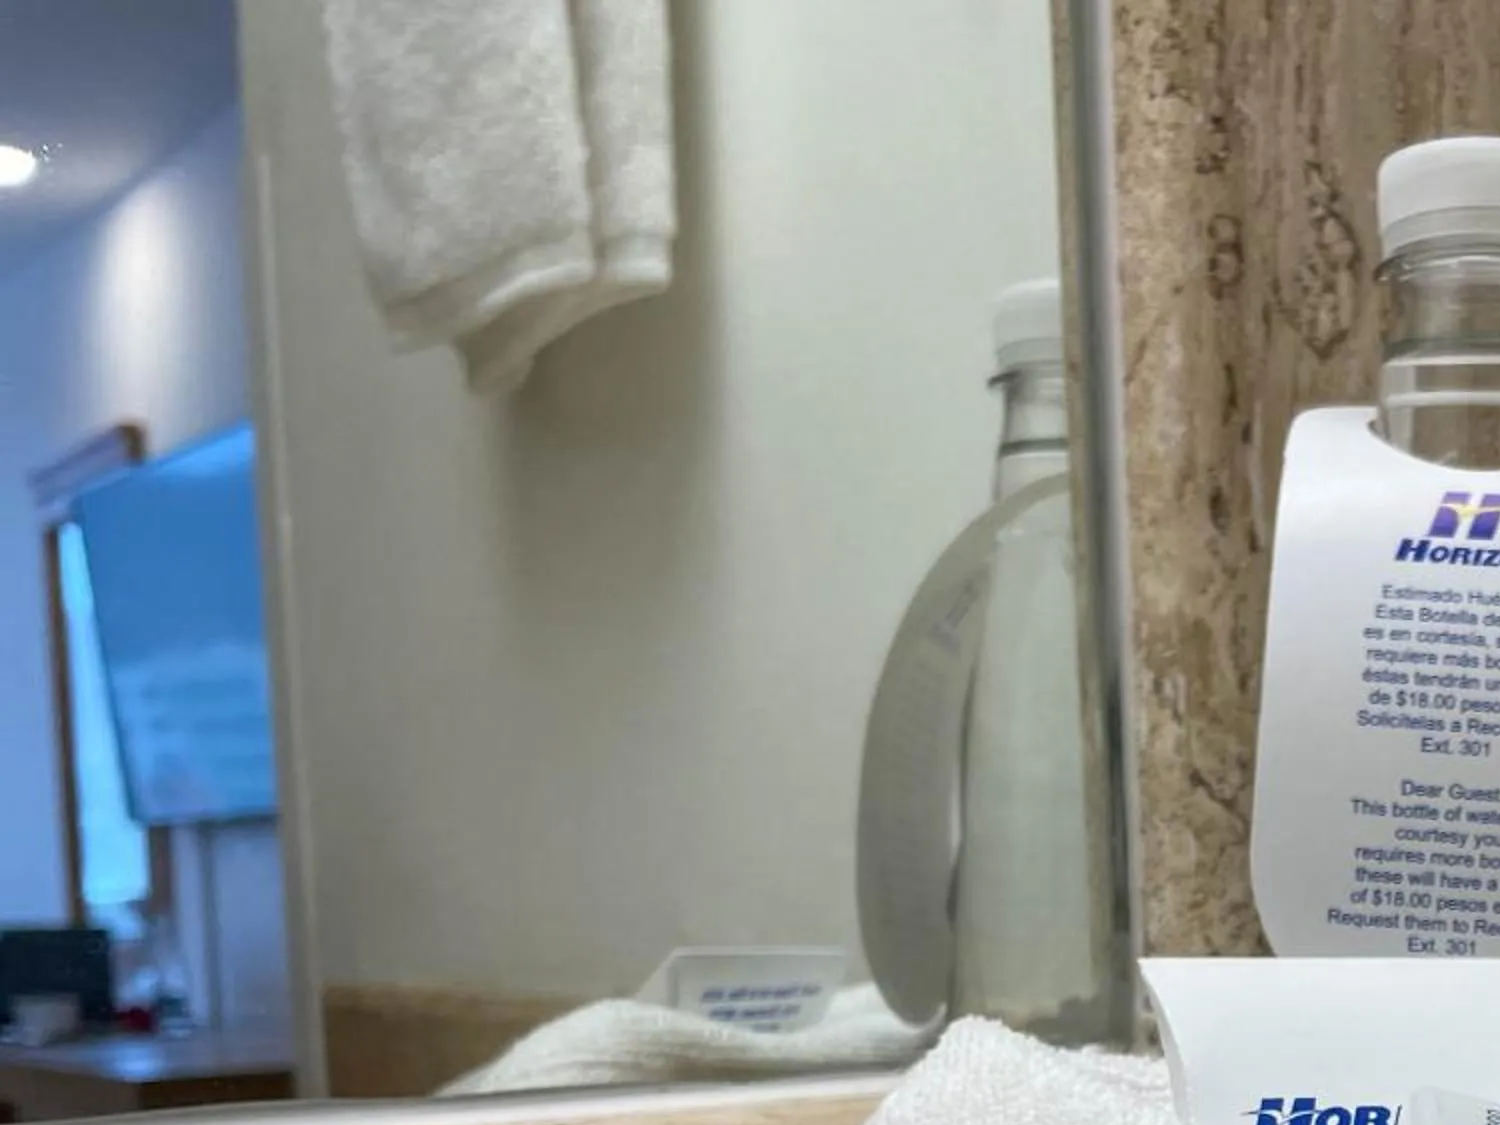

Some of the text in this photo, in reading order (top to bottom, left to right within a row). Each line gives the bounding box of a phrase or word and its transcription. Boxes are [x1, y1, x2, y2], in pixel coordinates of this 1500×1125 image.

[1382, 585, 1463, 604] Estimado
[1375, 604, 1414, 621] Esta
[1419, 607, 1478, 625] Botella
[1363, 627, 1384, 640] es
[1389, 629, 1411, 641] en
[1366, 649, 1437, 667] requiere
[1443, 652, 1479, 669] más
[1414, 671, 1480, 690] tendrán
[1368, 690, 1391, 705] de
[1396, 690, 1456, 709] $18.00
[1450, 719, 1462, 732] a
[1420, 736, 1491, 757] Ext. 301
[1400, 779, 1444, 797] Dear
[1351, 798, 1387, 816] This
[1392, 802, 1439, 821] bottle
[1443, 806, 1462, 822] of
[1394, 827, 1469, 848] courtesy
[1354, 846, 1426, 864] requires
[1429, 851, 1475, 867] more
[1355, 866, 1403, 884] these
[1407, 870, 1434, 886] will
[1439, 871, 1482, 890] have
[1487, 878, 1498, 892] a
[1350, 888, 1368, 904] of
[1372, 889, 1432, 909] $18.00
[1436, 897, 1487, 913] pesos
[1327, 908, 1400, 930] Request
[1404, 914, 1447, 932] them
[1452, 917, 1469, 933] to
[1407, 936, 1477, 955] Ext. 301
